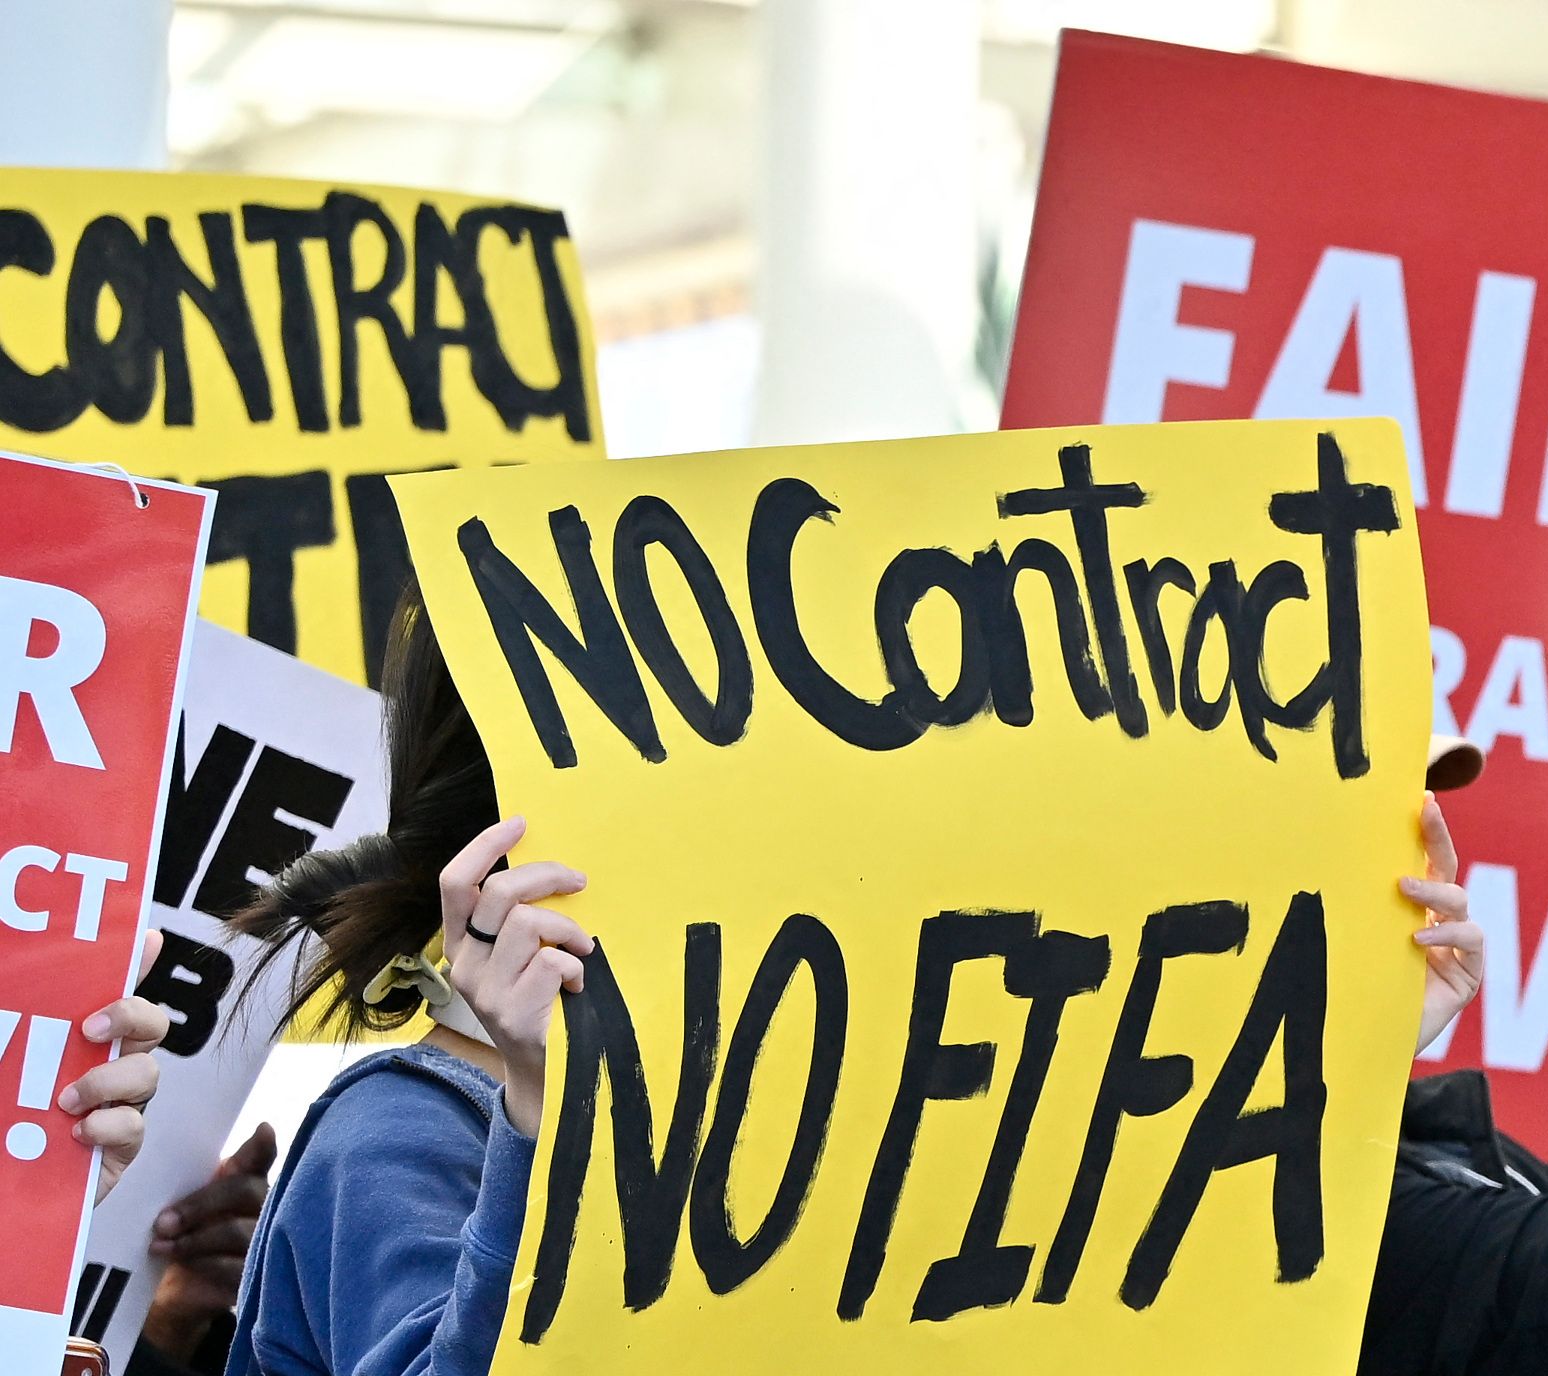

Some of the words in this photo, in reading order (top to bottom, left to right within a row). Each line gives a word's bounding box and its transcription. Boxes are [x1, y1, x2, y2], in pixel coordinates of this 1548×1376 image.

[0, 191, 592, 443] CONTRACT
[456, 495, 754, 768] NO
[745, 432, 1400, 780] Contract
[519, 911, 849, 1345] NO
[836, 890, 1328, 1326] FIFA
